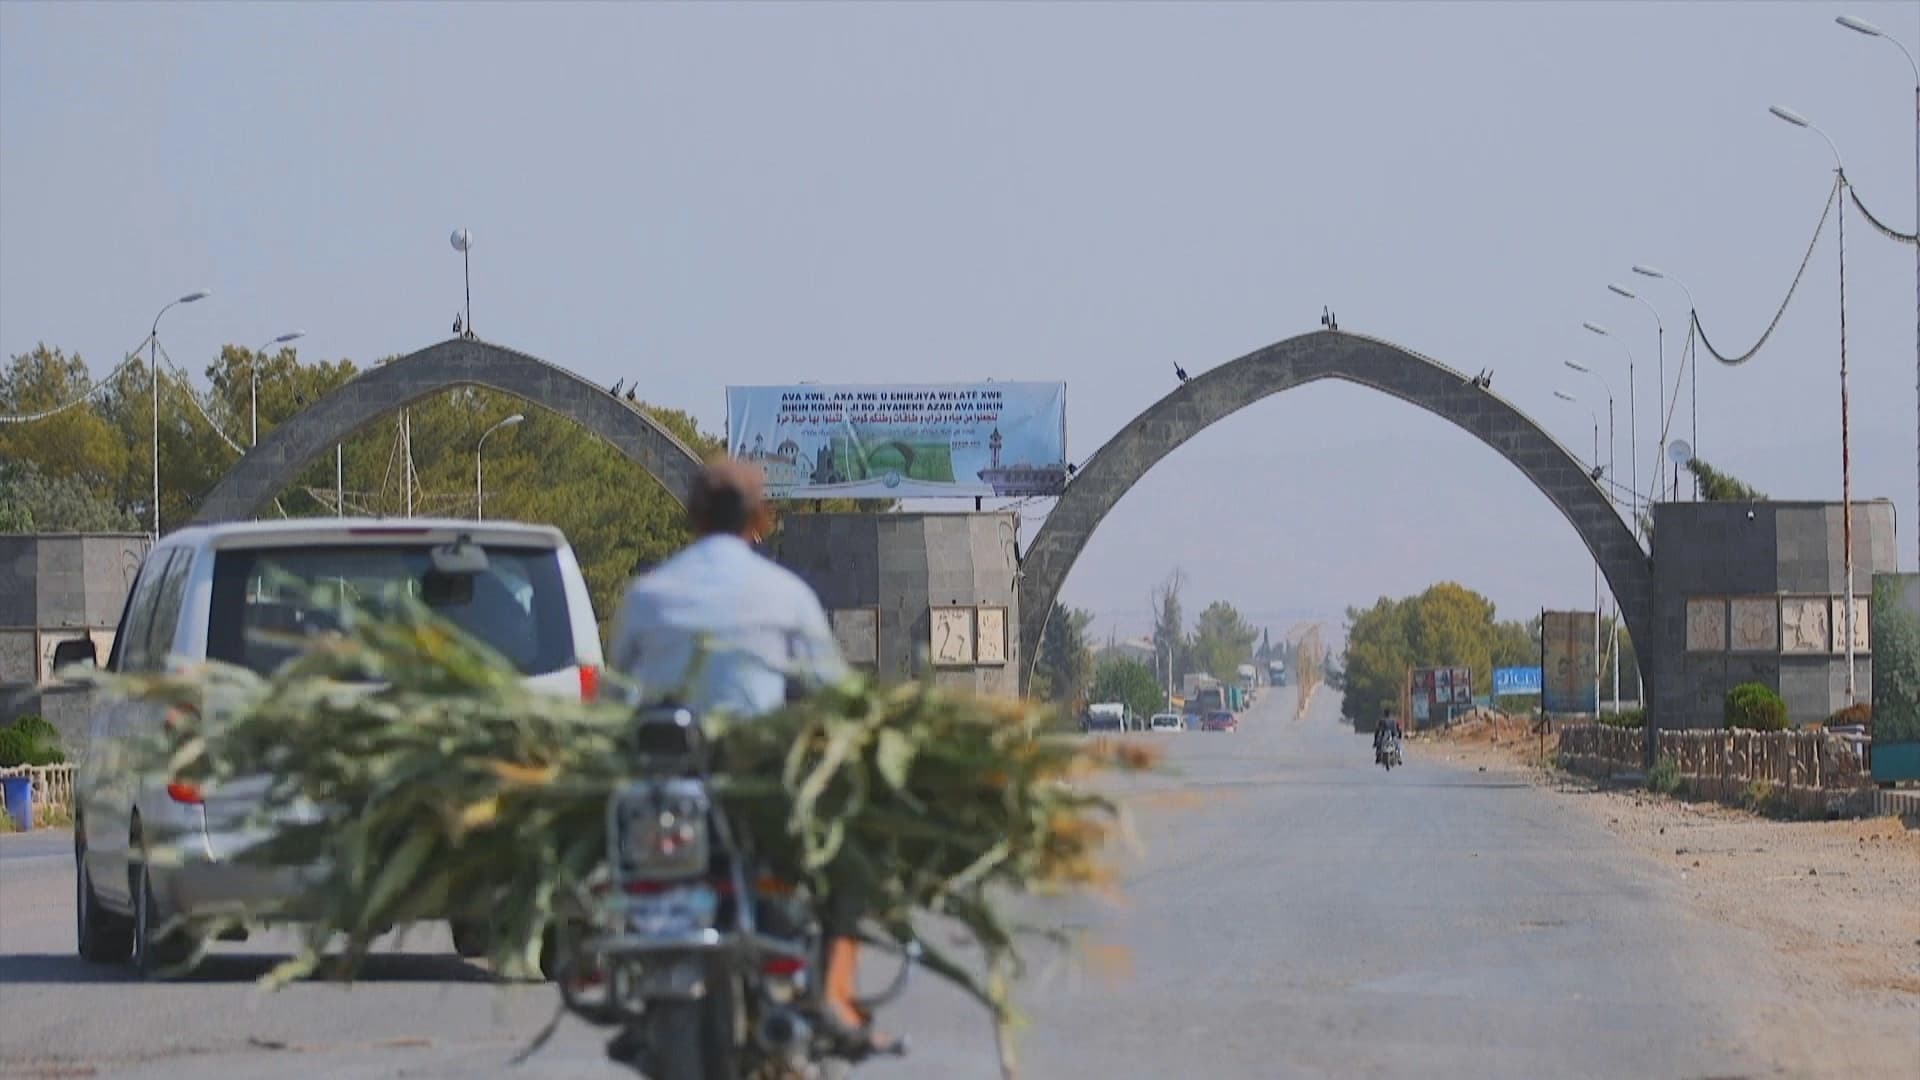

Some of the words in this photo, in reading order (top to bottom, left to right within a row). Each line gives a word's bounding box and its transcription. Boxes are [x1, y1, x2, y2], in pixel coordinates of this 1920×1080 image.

[781, 392, 802, 401] AVA
[804, 392, 826, 401] XWE
[857, 392, 878, 401] XWE
[980, 391, 1002, 400] XWE
[954, 402, 974, 411] AVA
